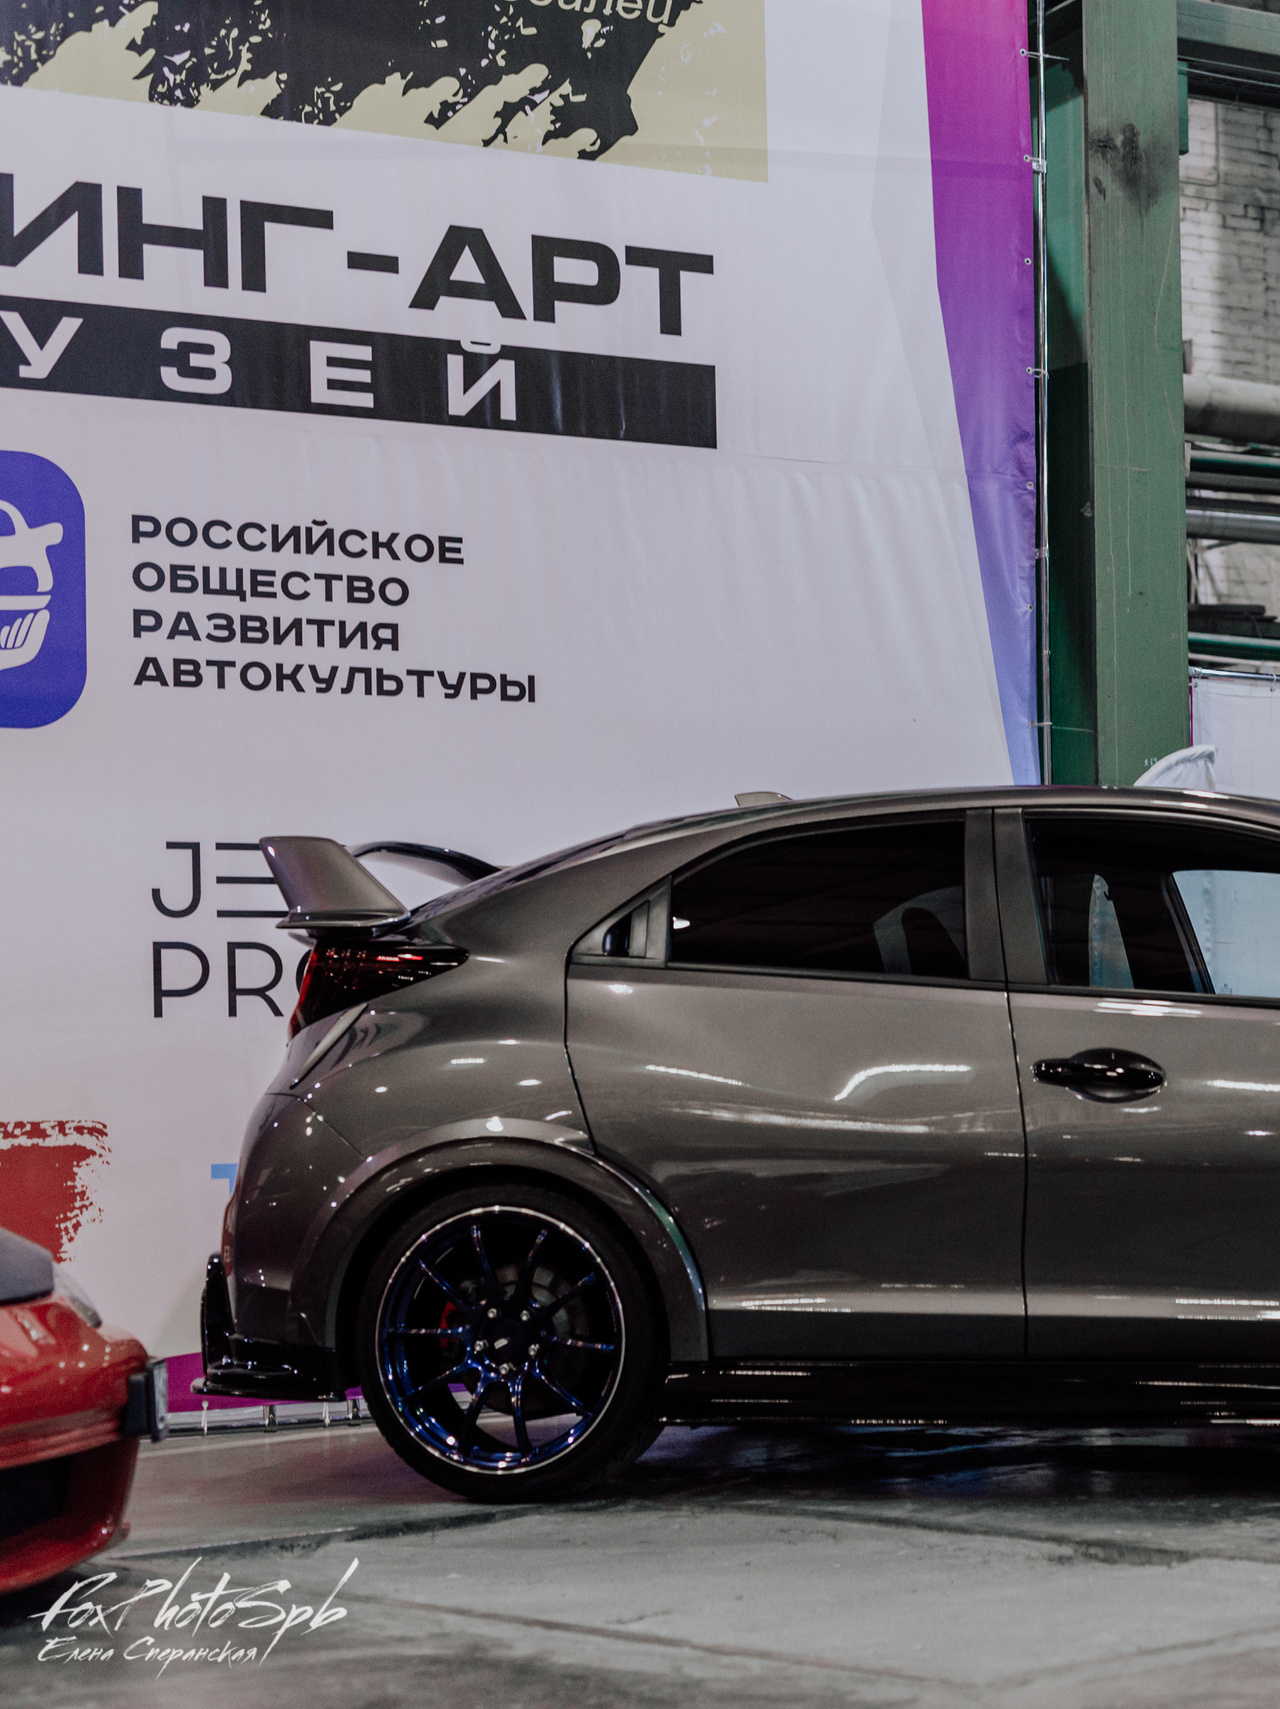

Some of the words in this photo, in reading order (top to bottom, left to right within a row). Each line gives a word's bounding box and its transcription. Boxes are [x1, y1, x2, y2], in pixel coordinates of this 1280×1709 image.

[0, 173, 714, 337] ИНГ-АРТ
[0, 311, 517, 421] УЗЕЙ
[131, 514, 465, 566] РОССИЙСКОЕ
[132, 561, 410, 607] ОБЩЕСТВО
[132, 608, 400, 652] РАЗВИТИЯ
[133, 656, 536, 703] АВТОКУЛЬТУРЫ
